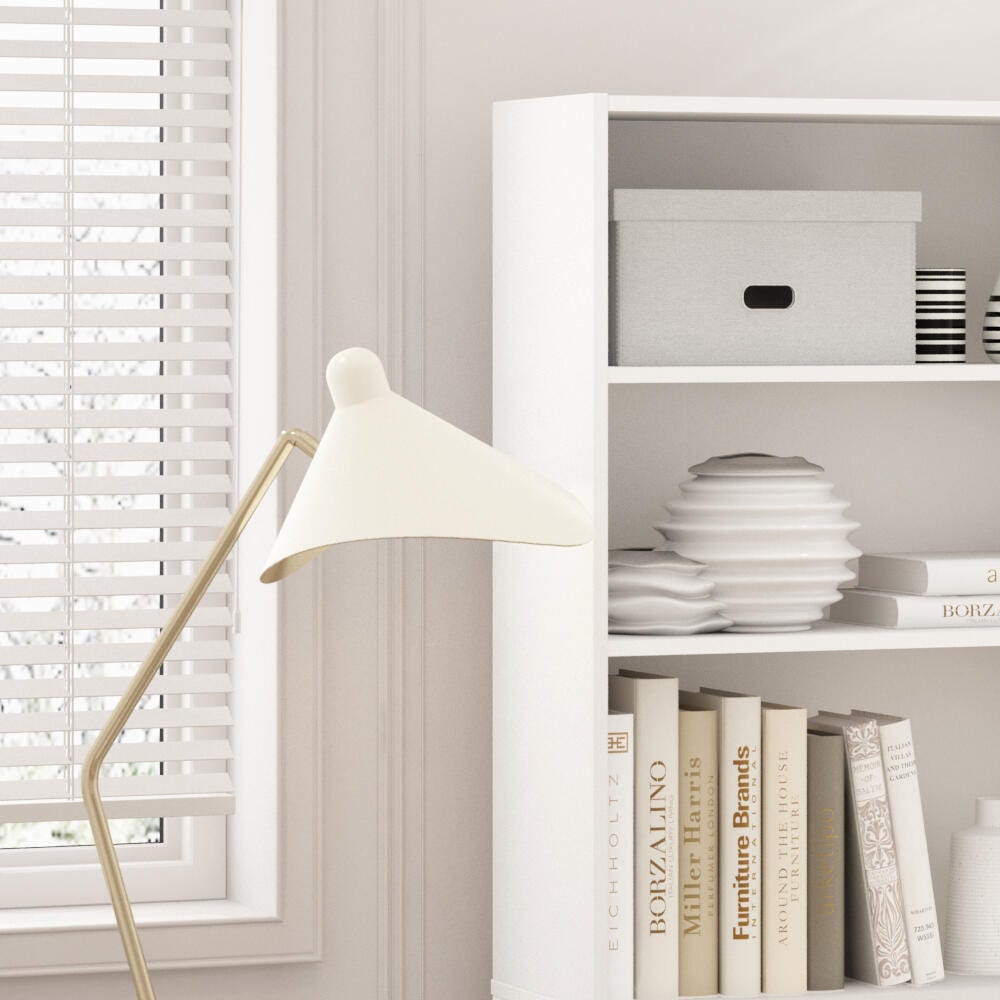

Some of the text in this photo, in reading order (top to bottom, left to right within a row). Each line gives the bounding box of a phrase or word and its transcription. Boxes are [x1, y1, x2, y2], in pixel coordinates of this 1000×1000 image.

[608, 774, 619, 951] EICHHOLTZ
[649, 760, 667, 936] BORZALINO
[684, 757, 701, 936] Miller Harris
[733, 745, 750, 940] Furniture Brands
[779, 751, 788, 945] AROUND THE HOUSE
[791, 794, 799, 902] FURNITURE
[817, 807, 839, 916] arketipo
